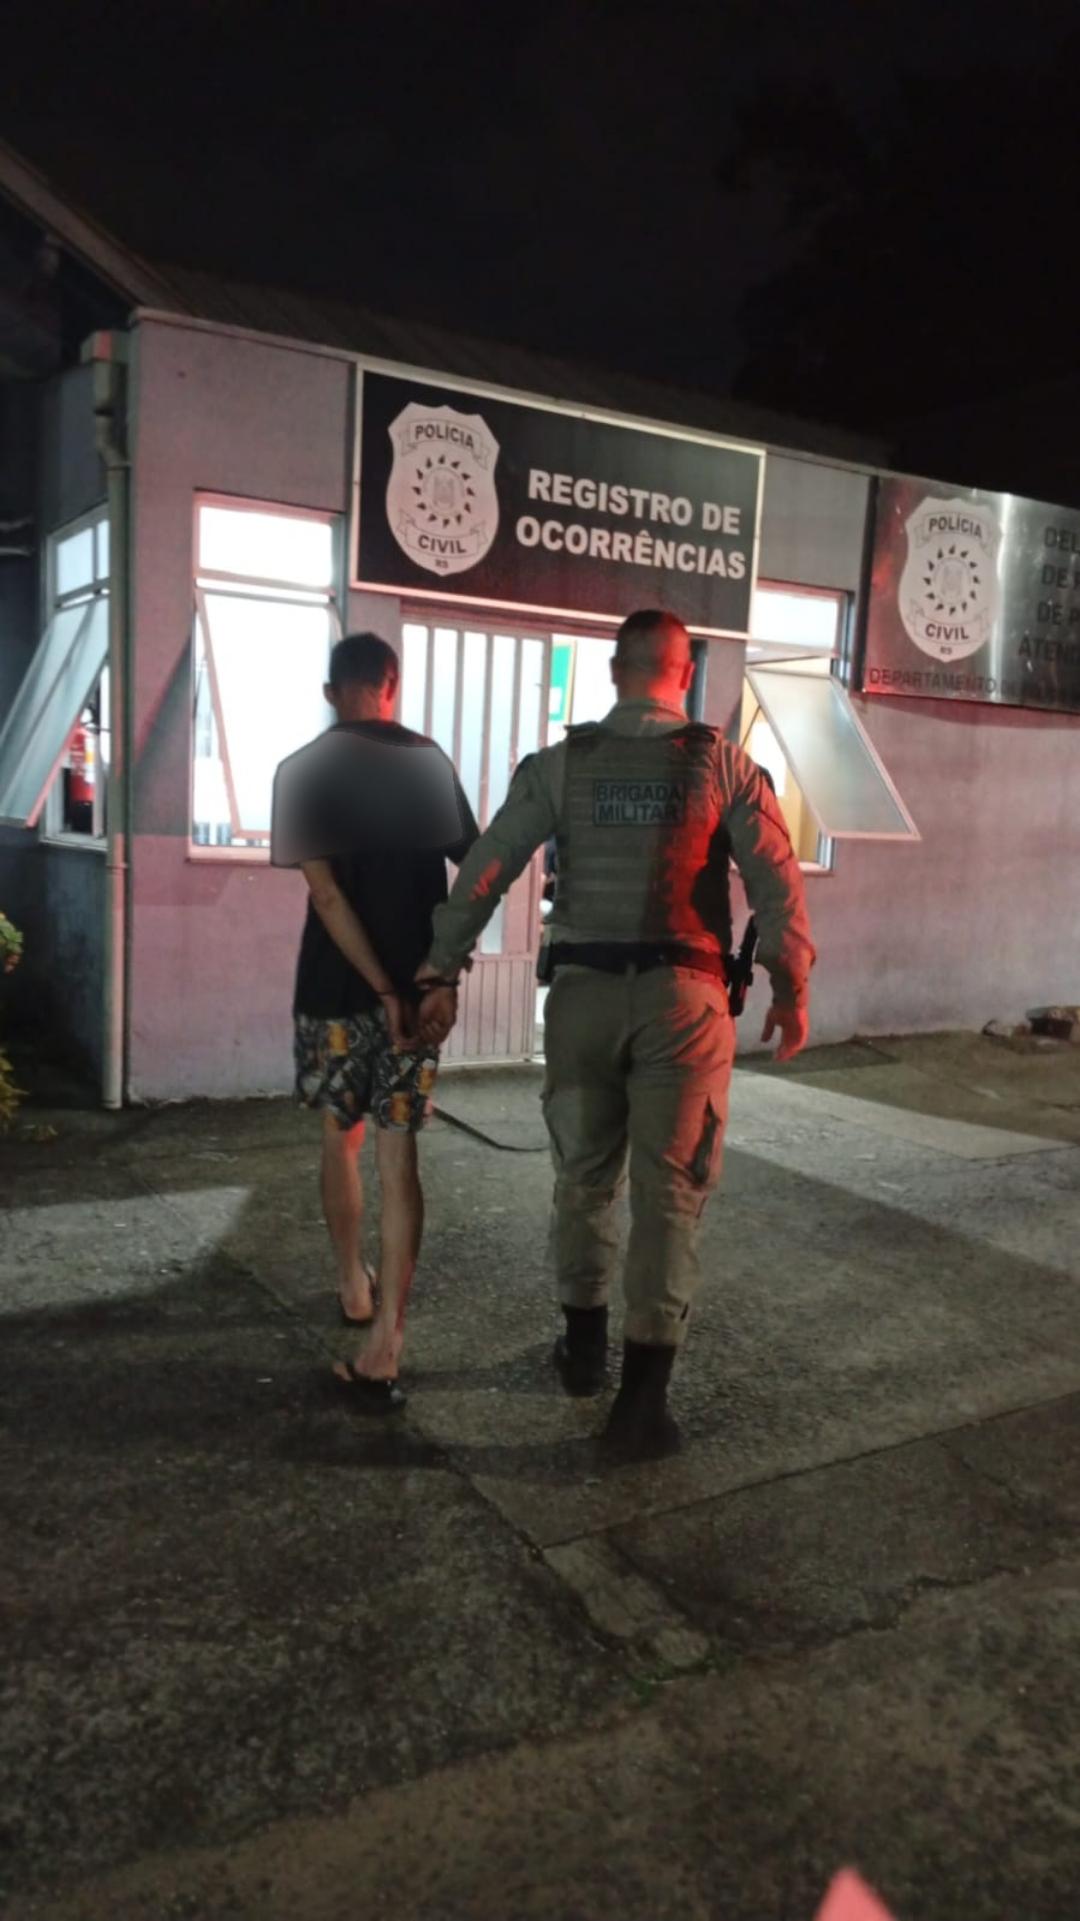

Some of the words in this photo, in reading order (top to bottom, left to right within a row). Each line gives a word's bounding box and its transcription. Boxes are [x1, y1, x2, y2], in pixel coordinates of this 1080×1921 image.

[414, 421, 475, 451] POLÍCIA
[528, 468, 692, 526] REGISTRO
[701, 502, 741, 535] DE
[928, 516, 983, 538] POLÍCIA
[418, 533, 468, 555] CIVIL
[515, 515, 747, 579] OCORRÊNCIAS
[925, 623, 969, 641] CIVIL
[870, 668, 997, 693] DEPARTAMENTO
[598, 784, 680, 802] BRIGADA
[598, 804, 679, 821] MILITAR
